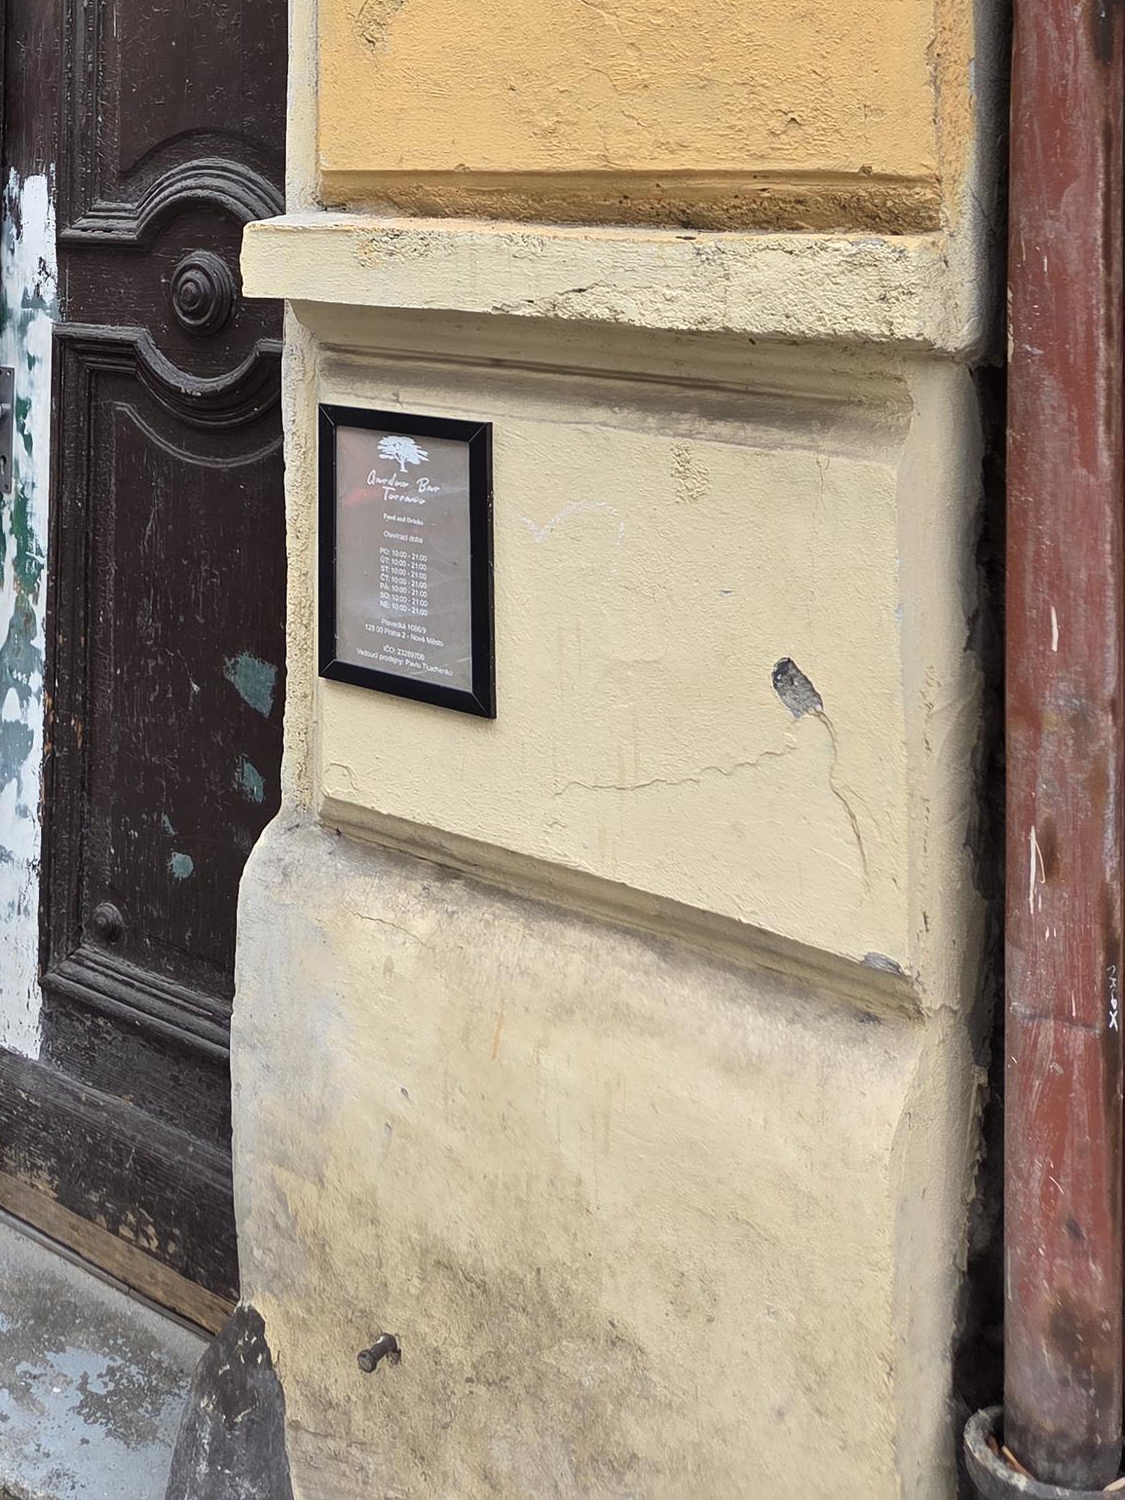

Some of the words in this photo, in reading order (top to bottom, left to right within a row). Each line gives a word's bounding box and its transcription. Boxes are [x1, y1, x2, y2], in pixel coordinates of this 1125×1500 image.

[396, 515, 406, 523] and
[406, 517, 424, 525] Drinks
[411, 553, 427, 562] 21:00
[411, 562, 427, 570] 21:00
[411, 570, 427, 580] 21:00
[411, 580, 427, 589] 21:00
[411, 588, 427, 598] 21:00
[411, 598, 427, 607] 21:00
[411, 606, 427, 616] 21:00
